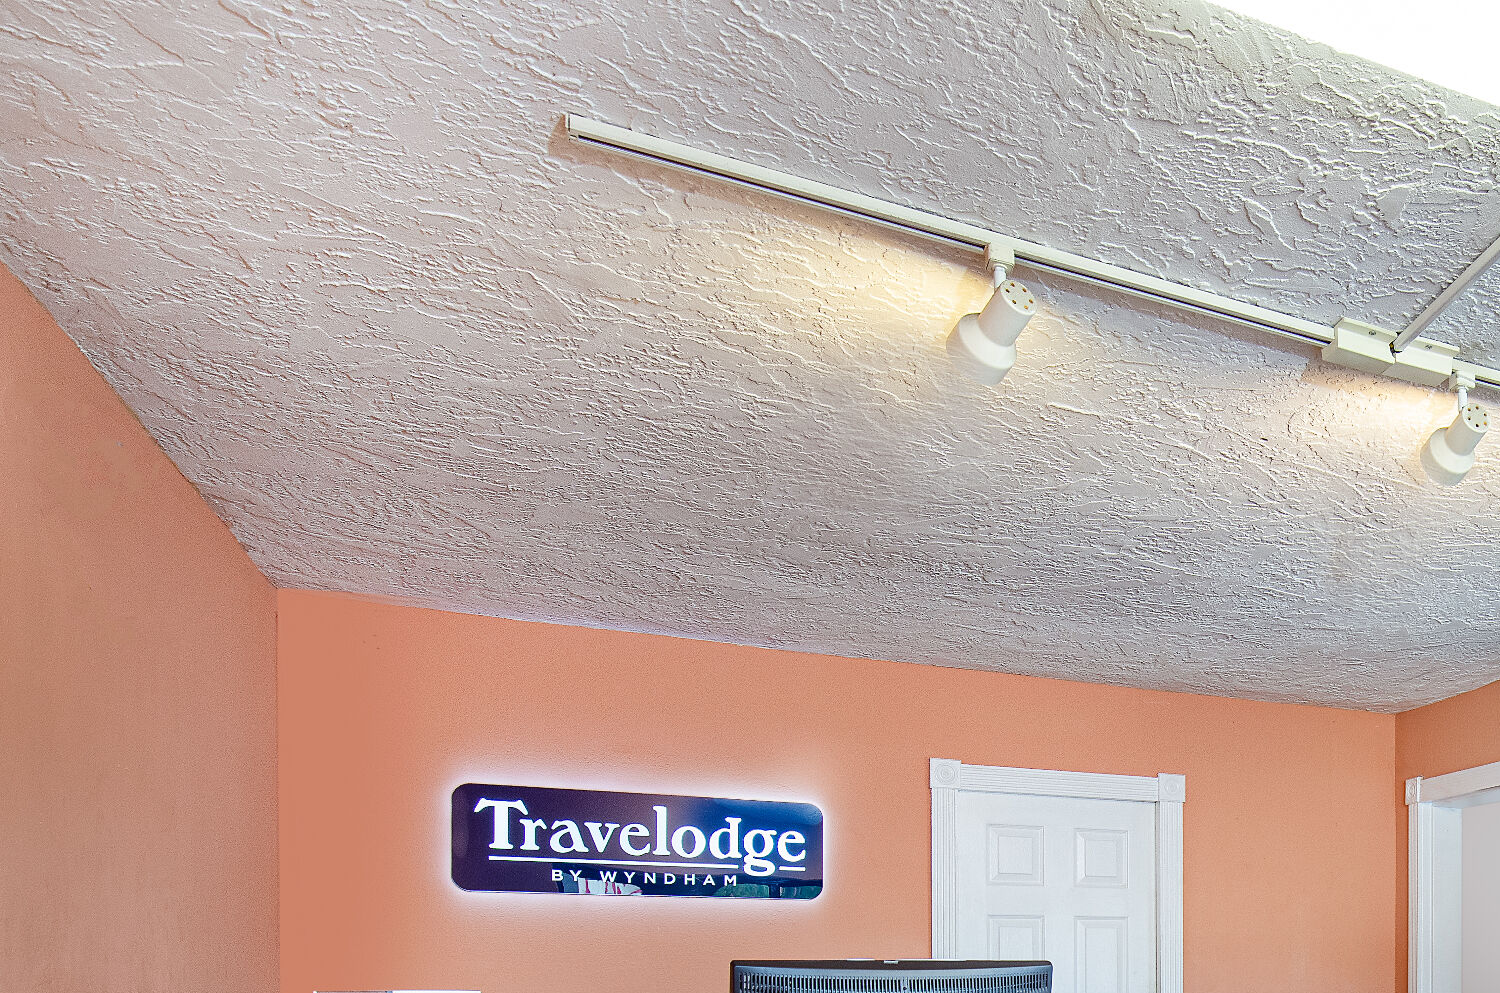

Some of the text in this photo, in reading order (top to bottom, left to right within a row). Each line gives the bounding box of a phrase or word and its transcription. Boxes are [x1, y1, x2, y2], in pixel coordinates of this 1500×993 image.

[473, 797, 806, 877] Travelodge
[551, 868, 738, 887] BY WYNDHAM
